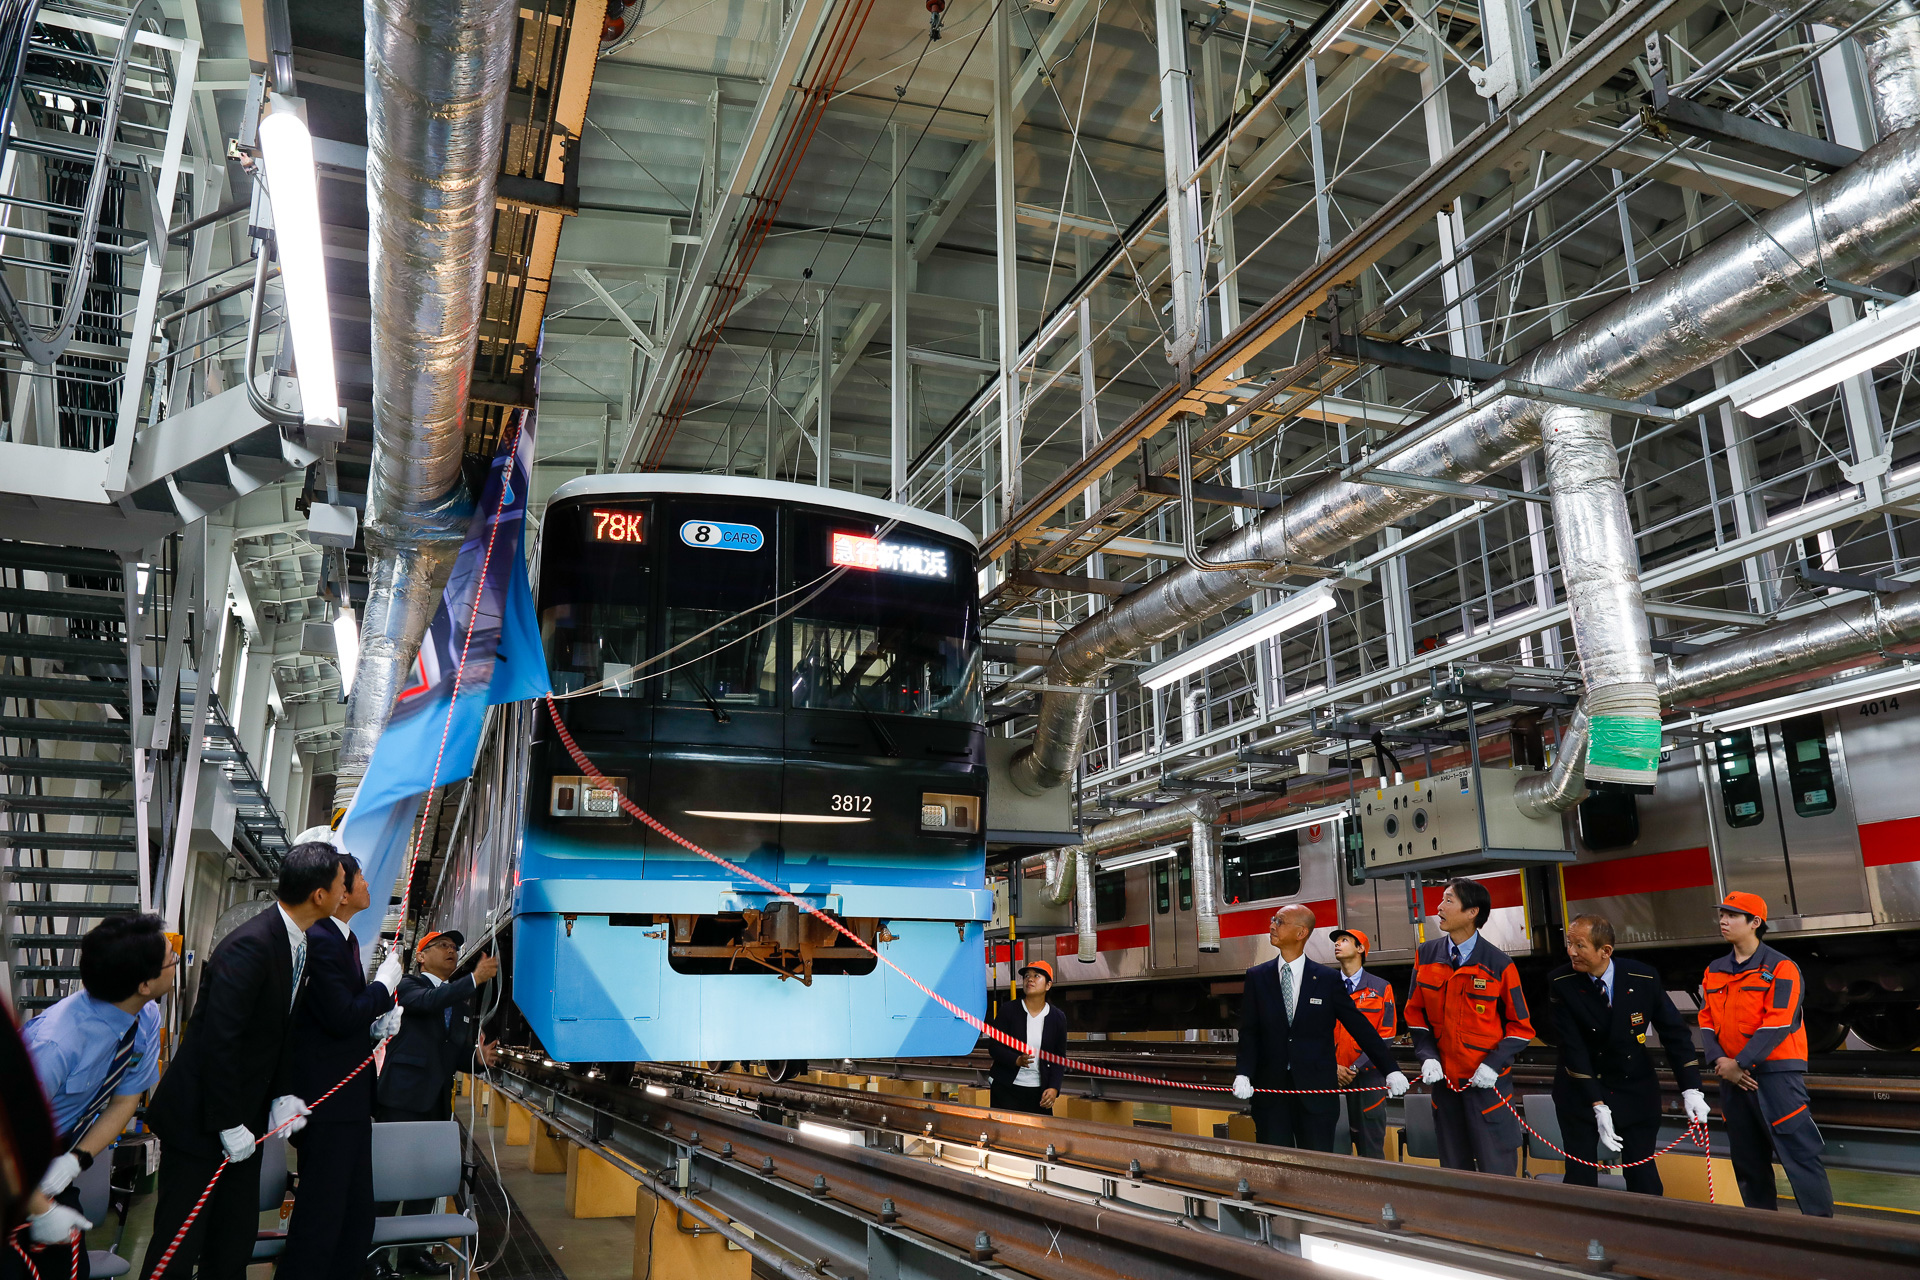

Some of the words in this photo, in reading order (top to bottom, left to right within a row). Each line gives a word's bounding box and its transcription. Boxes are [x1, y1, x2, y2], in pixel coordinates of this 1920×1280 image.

[593, 511, 642, 542] 78K
[695, 525, 711, 543] 8
[723, 531, 758, 545] CARS
[834, 537, 877, 566] 急行
[877, 542, 947, 578] 新横浜
[1859, 697, 1900, 717] 4014
[831, 794, 872, 812] 3812
